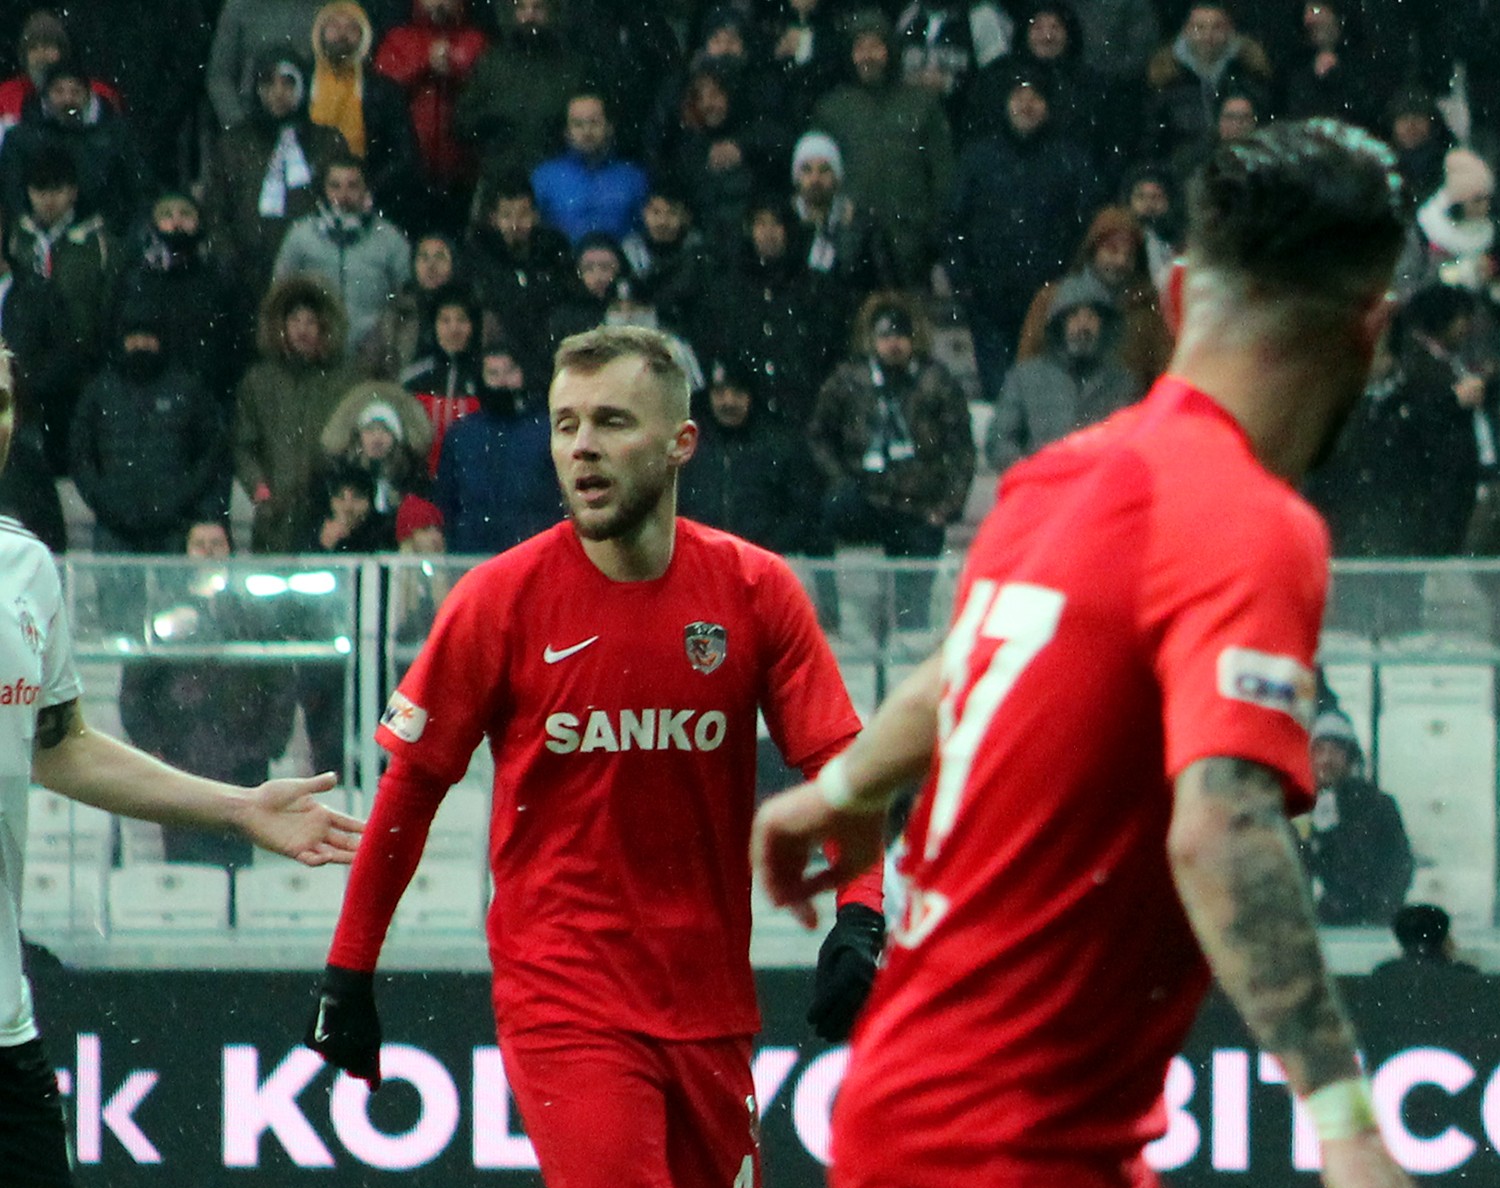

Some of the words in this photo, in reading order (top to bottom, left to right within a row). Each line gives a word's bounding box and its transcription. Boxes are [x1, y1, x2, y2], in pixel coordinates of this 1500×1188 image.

[0, 676, 41, 705] afo
[544, 708, 728, 754] SANKO
[56, 1033, 162, 1164] k
